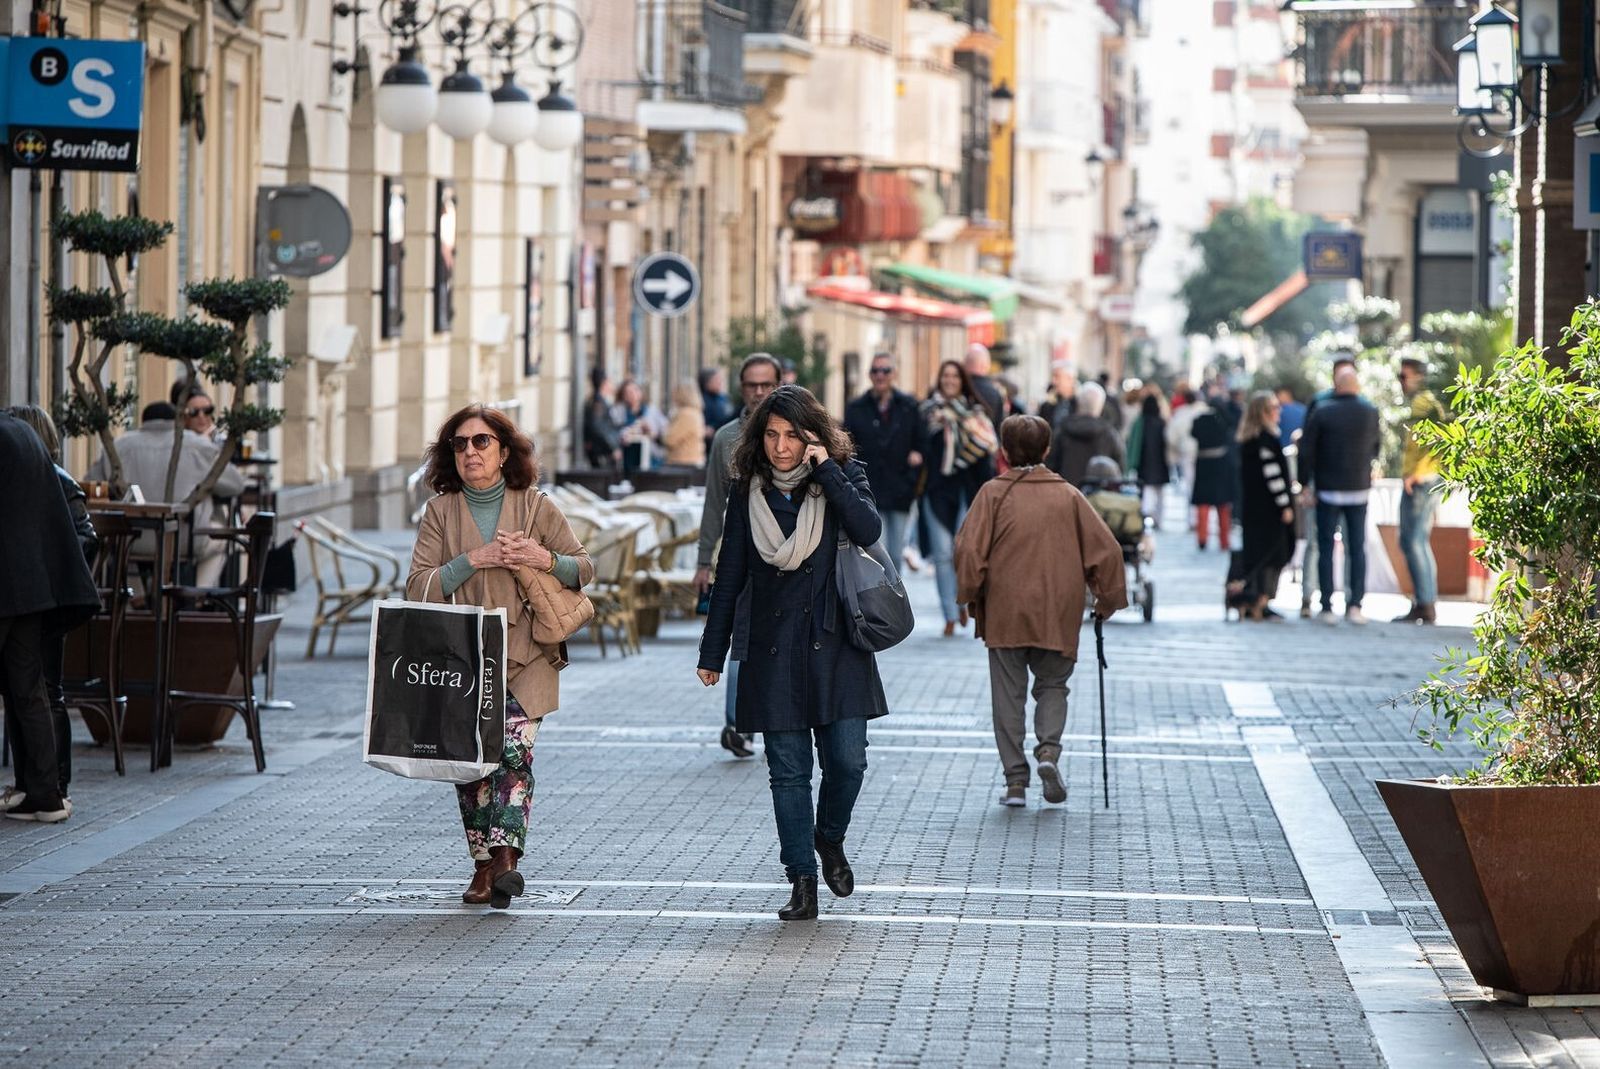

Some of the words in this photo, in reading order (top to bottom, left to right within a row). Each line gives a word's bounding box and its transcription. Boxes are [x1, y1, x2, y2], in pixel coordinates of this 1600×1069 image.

[41, 57, 58, 77] B
[68, 57, 116, 119] S
[51, 139, 130, 160] ServiRed
